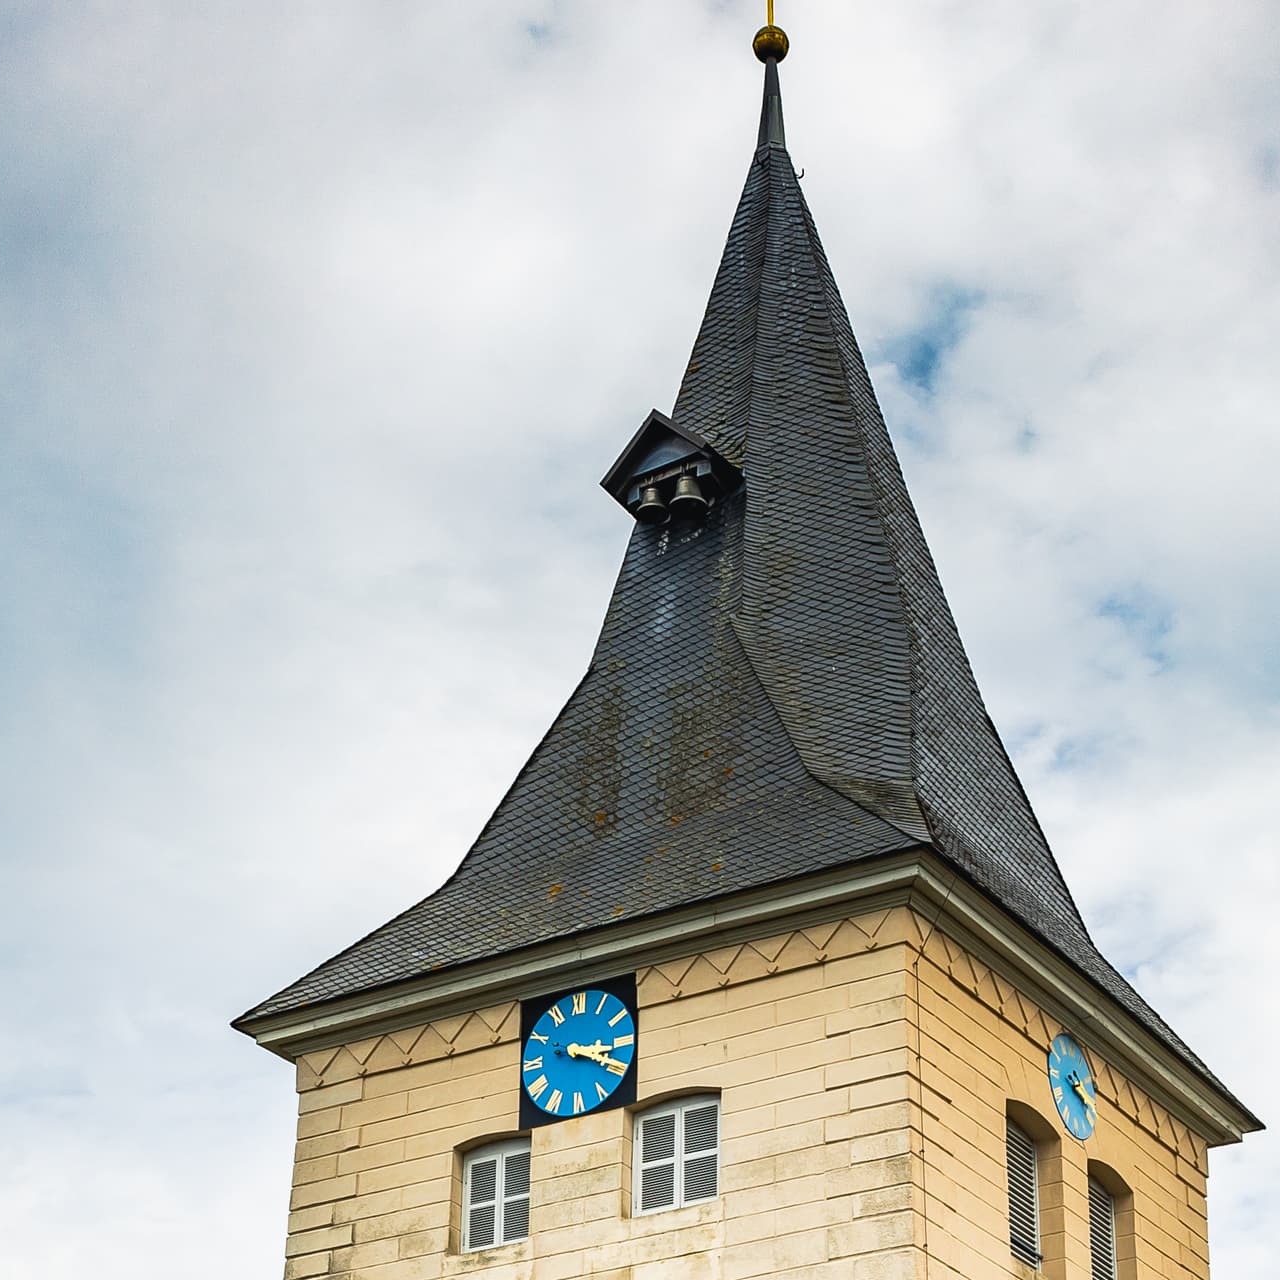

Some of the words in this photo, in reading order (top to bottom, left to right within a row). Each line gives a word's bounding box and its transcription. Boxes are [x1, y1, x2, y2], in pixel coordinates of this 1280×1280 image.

[571, 991, 587, 1016] XII
[547, 1005, 566, 1027] XI
[607, 1008, 628, 1027] II
[529, 1031, 549, 1045] X
[613, 1033, 634, 1049] III
[523, 1056, 543, 1072] IX
[527, 1074, 549, 1101] VIII
[595, 1082, 609, 1102] V
[544, 1088, 563, 1114] VII
[573, 1091, 586, 1114] VI
